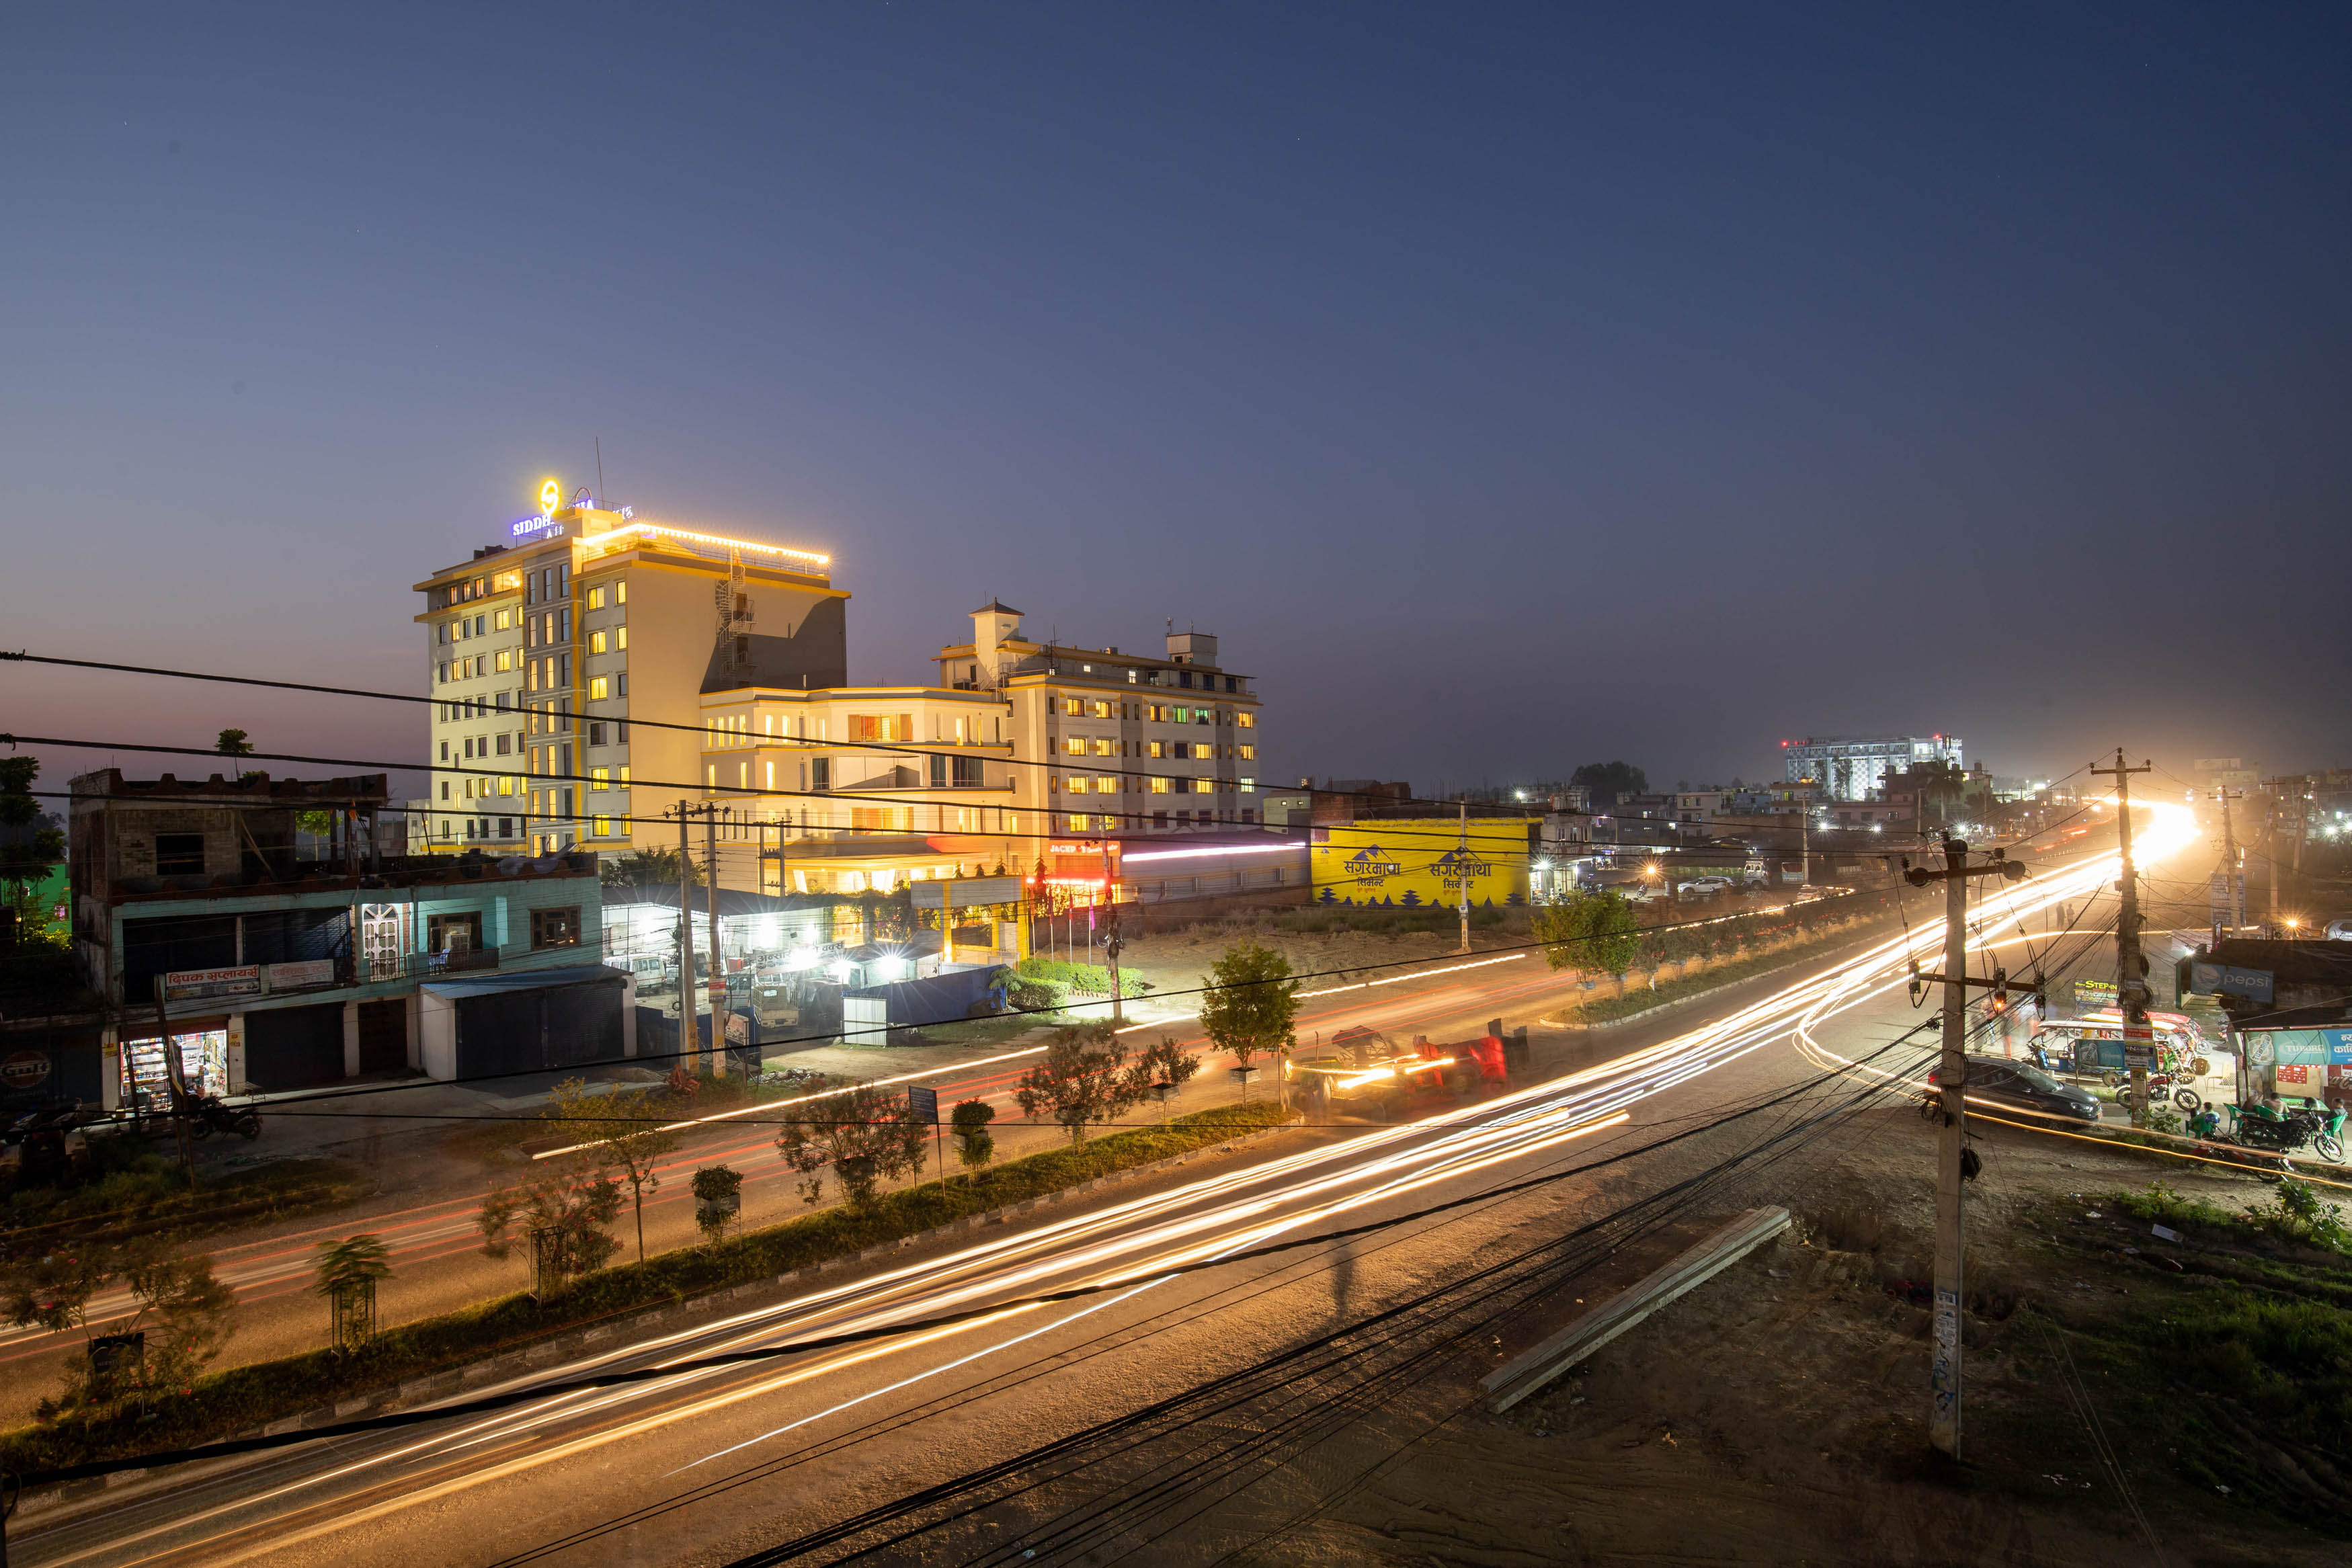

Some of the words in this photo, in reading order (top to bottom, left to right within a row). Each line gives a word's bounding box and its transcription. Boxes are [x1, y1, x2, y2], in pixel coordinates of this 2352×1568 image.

[1344, 860, 1401, 876] सगरमाथा
[169, 973, 203, 985] दिपक
[2224, 974, 2269, 987] pepsi
[2253, 1035, 2271, 1061] TUBORG
[2285, 1044, 2325, 1054] TUBORG
